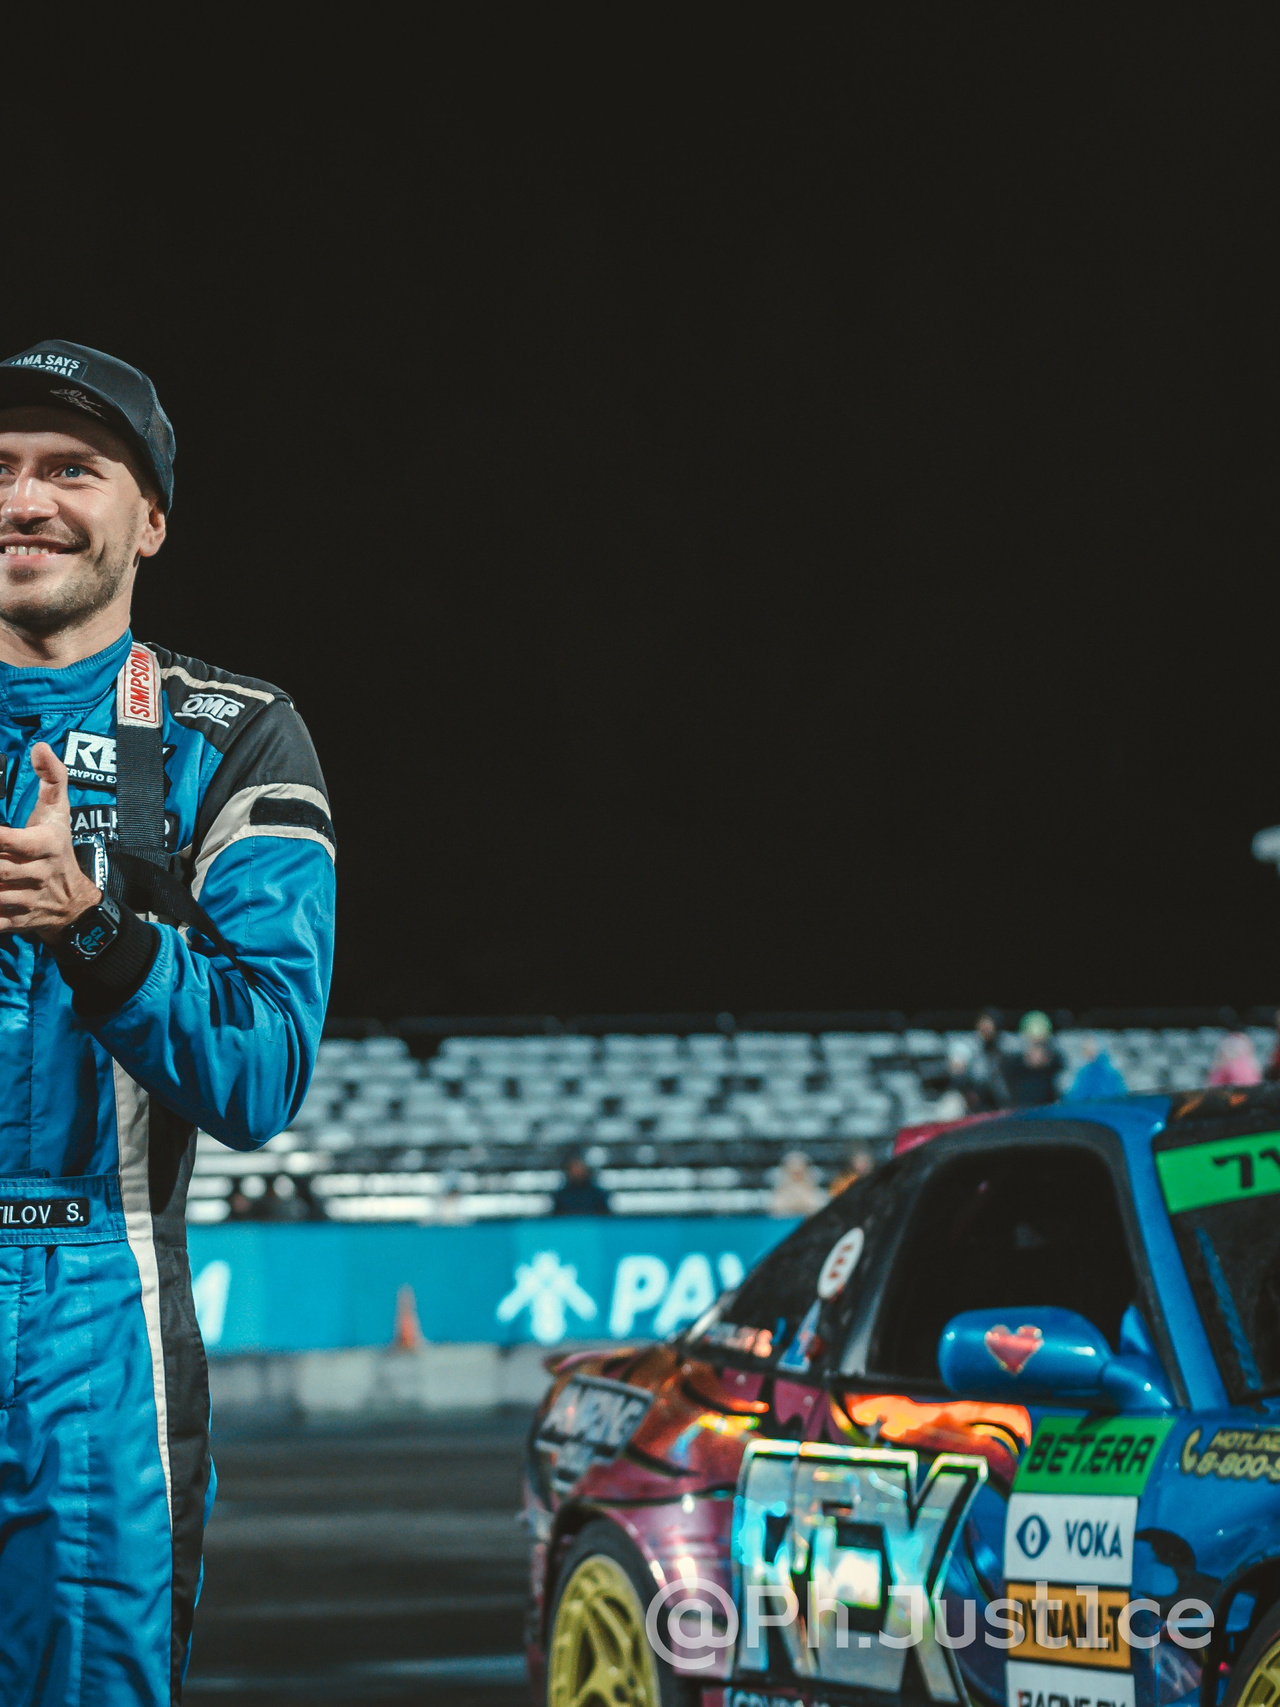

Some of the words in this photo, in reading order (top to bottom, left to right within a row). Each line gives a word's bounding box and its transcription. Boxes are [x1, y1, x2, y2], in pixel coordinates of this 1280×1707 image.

[45, 354, 80, 369] SAYS
[129, 649, 150, 718] SIMPSON
[181, 697, 240, 719] OMP
[66, 1203, 84, 1222] S.
[1066, 1519, 1123, 1559] VOKA
